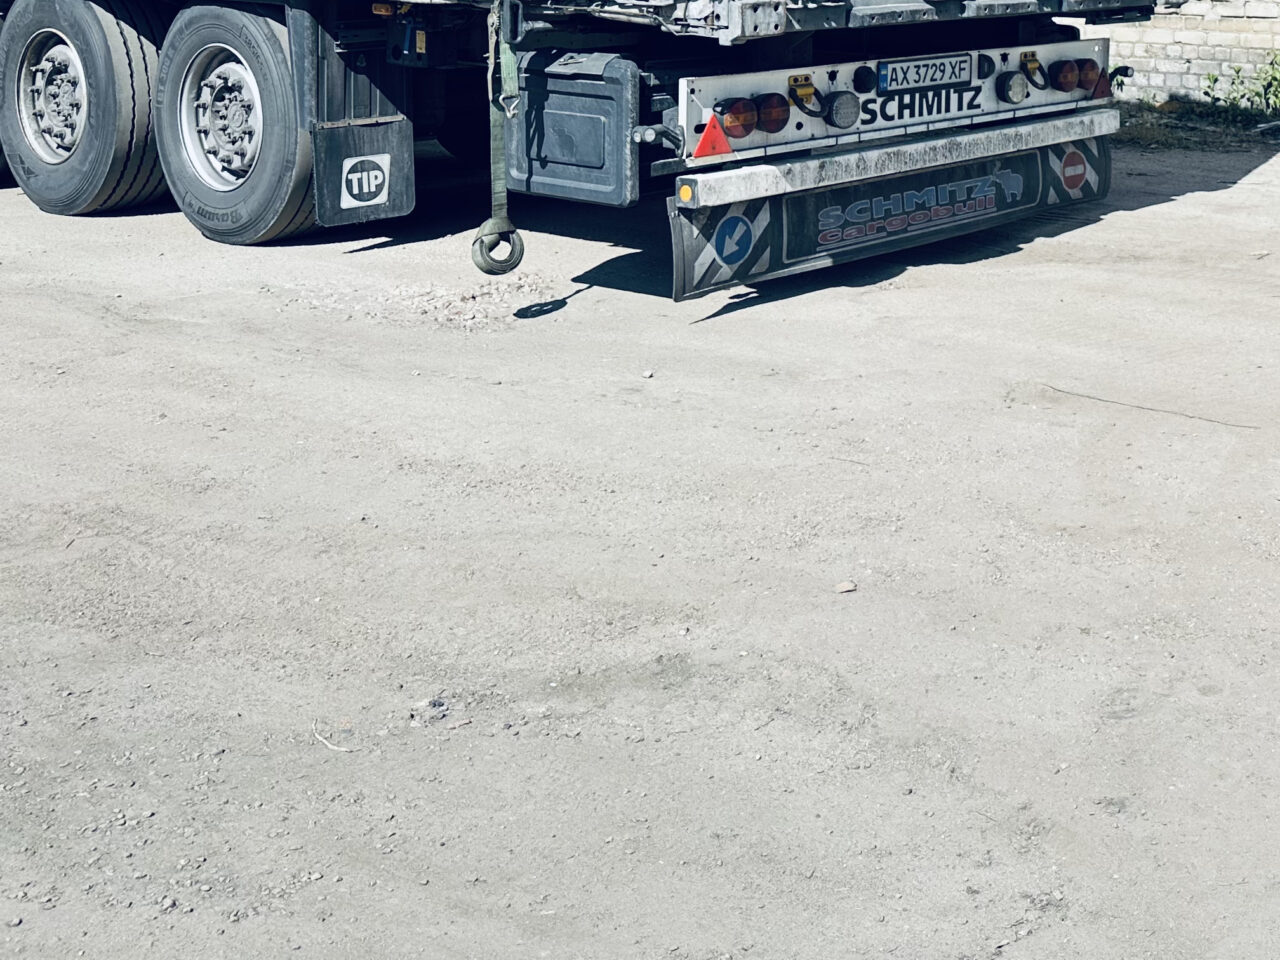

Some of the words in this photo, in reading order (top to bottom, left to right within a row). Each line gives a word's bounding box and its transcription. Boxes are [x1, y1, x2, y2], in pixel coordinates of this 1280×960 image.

[889, 65, 911, 88] AX
[913, 62, 946, 84] 3729
[948, 60, 968, 81] XF
[860, 85, 983, 126] SCHMITZ
[347, 169, 384, 195] TIP
[818, 175, 996, 230] SCHMITZ
[817, 194, 996, 245] cargobull
